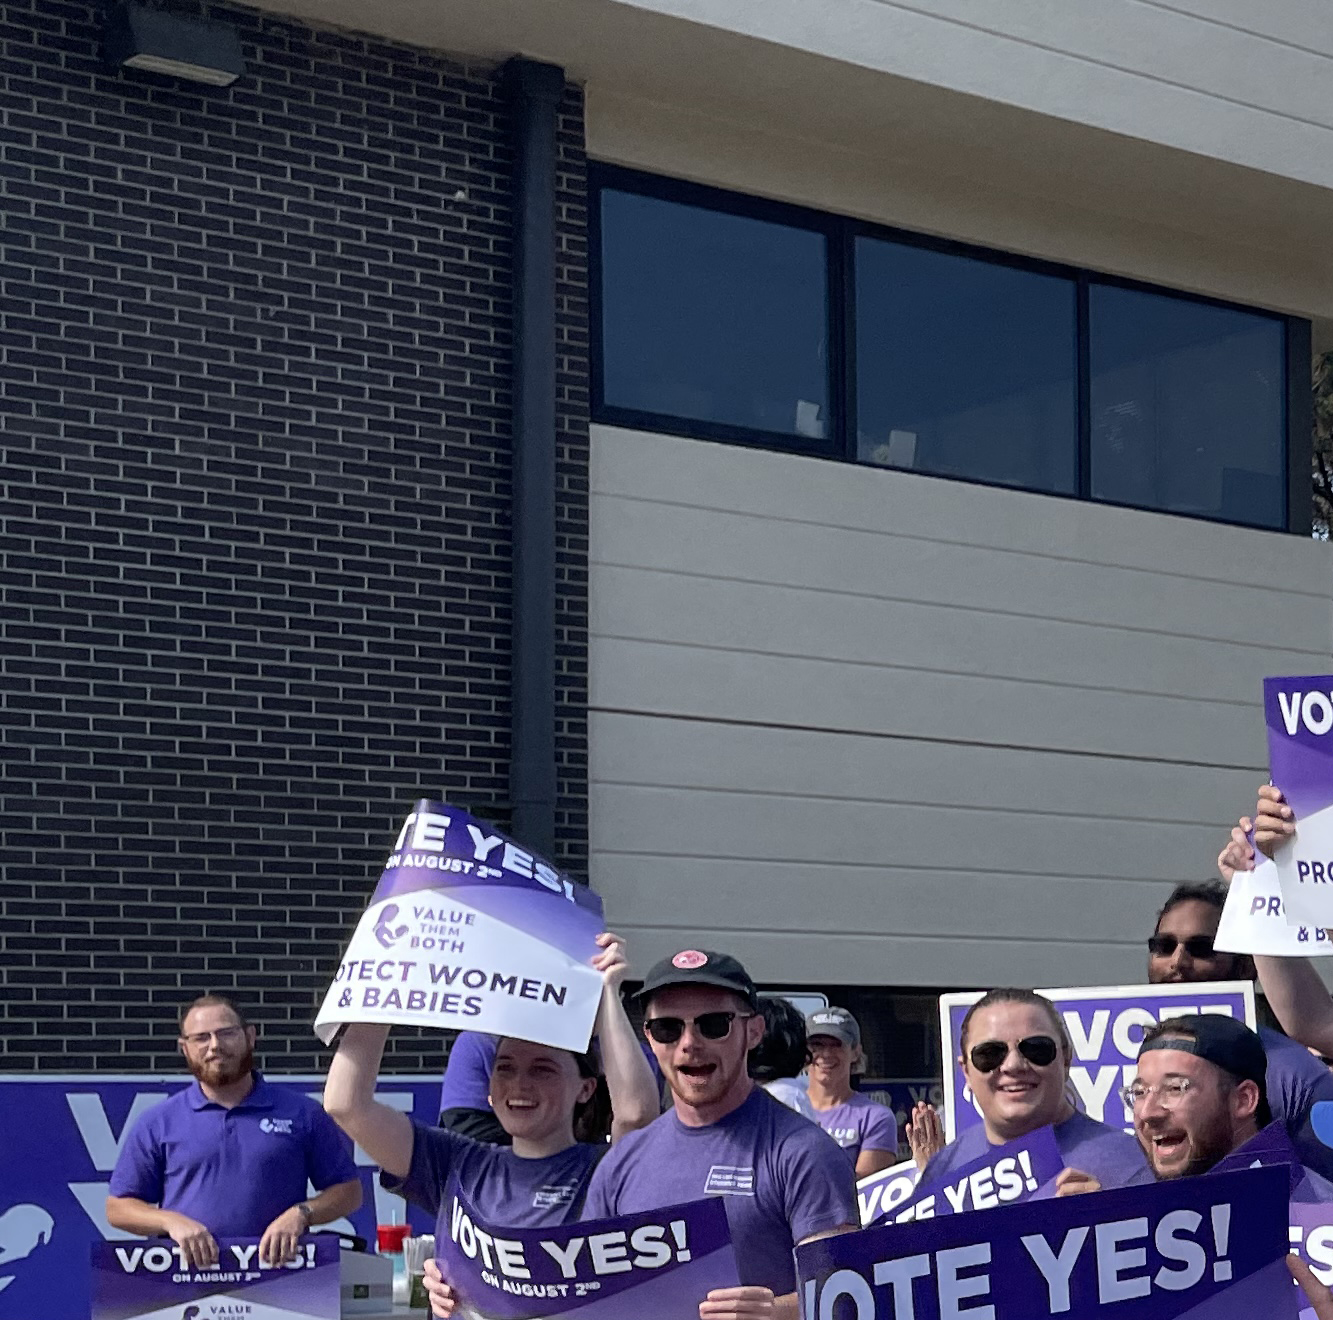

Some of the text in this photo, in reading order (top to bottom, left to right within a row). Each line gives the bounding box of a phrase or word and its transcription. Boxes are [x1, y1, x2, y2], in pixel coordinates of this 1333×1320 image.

[403, 854, 474, 874] AUGUST
[466, 824, 575, 903] YES!
[413, 906, 476, 926] VALUE
[420, 924, 459, 936] THEM
[410, 936, 464, 952] BOTH
[429, 962, 567, 1006] WOMEN
[338, 987, 353, 1007] &
[362, 986, 483, 1016] BABIES
[944, 1150, 1038, 1213] YES!
[451, 1196, 530, 1279] VOTE
[540, 1220, 691, 1278] YES!
[1021, 1204, 1233, 1314] YES!
[481, 1271, 499, 1288] ON
[503, 1277, 568, 1297] AUGUST
[210, 1305, 252, 1314] VALUE
